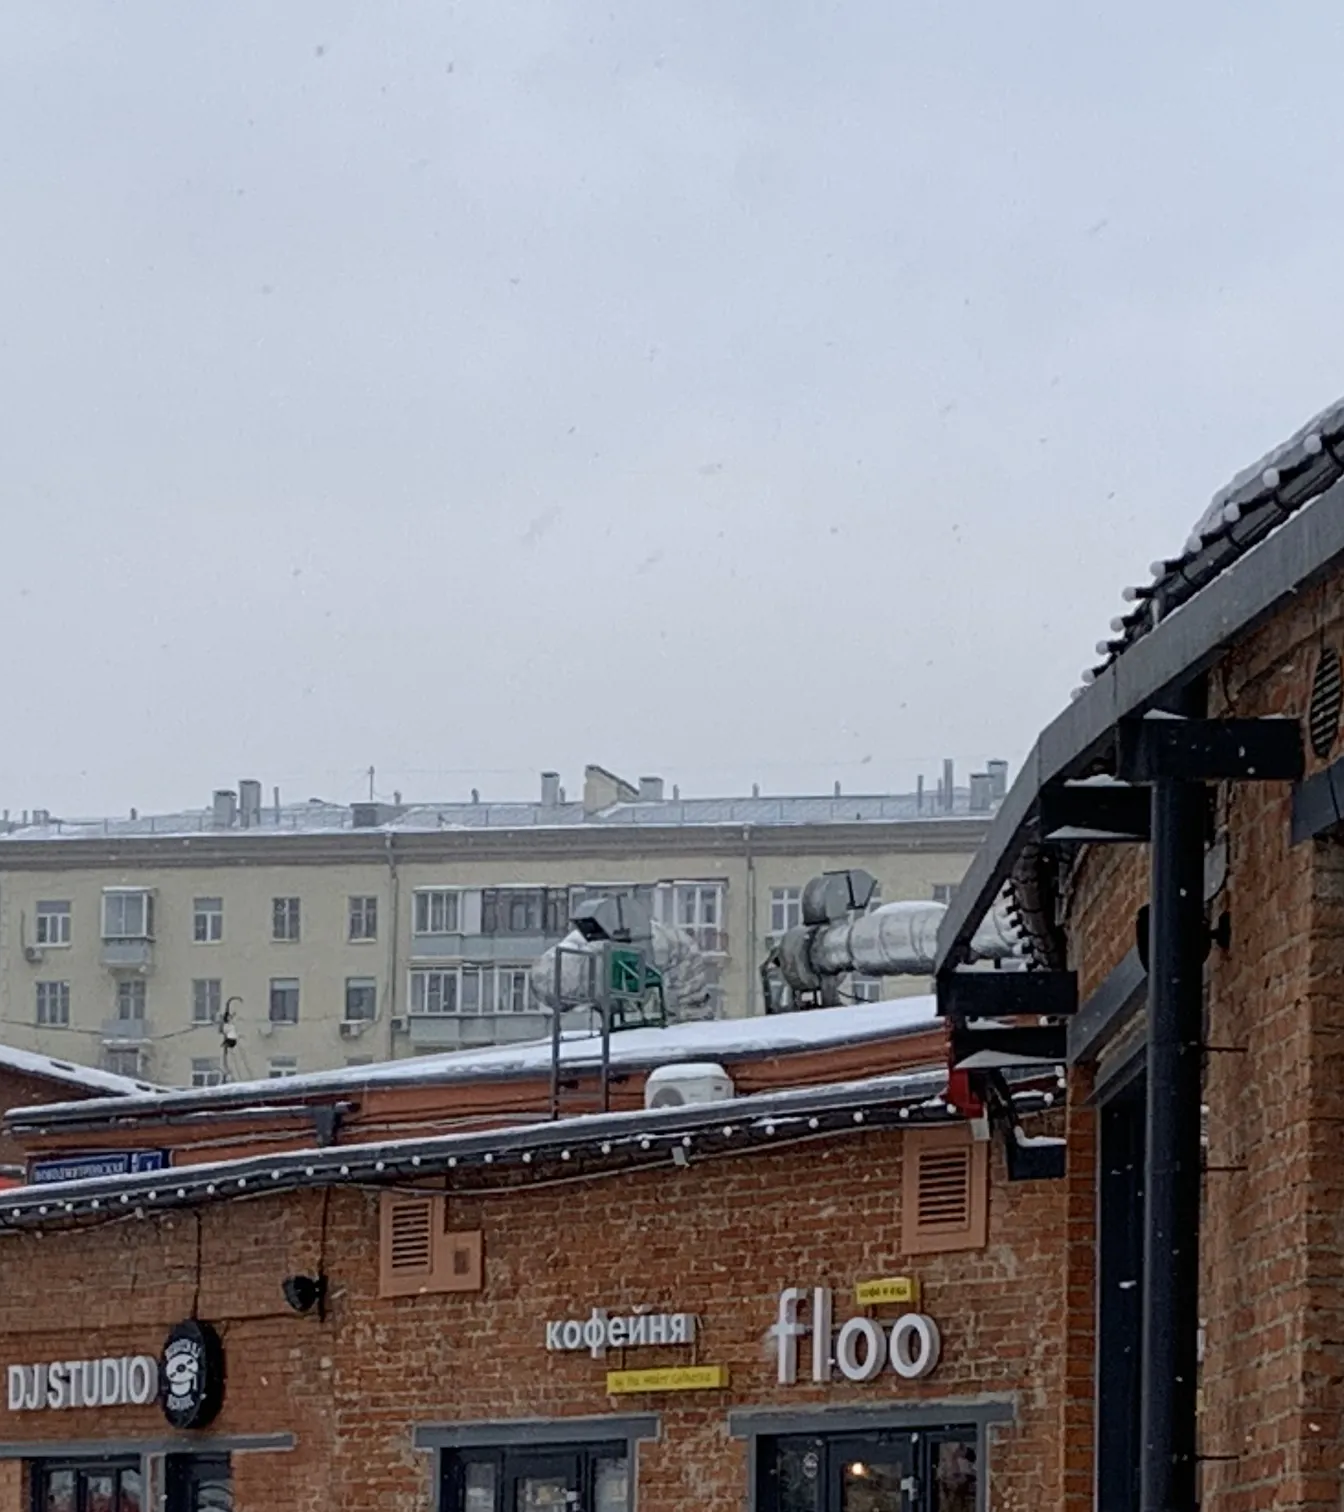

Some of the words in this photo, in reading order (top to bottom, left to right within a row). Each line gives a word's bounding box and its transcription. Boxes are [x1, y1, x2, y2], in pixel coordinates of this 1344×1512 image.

[545, 1305, 691, 1359] кофейня
[761, 1286, 938, 1384] floo
[8, 1363, 43, 1410] DJ
[47, 1354, 156, 1410] STUDIO
